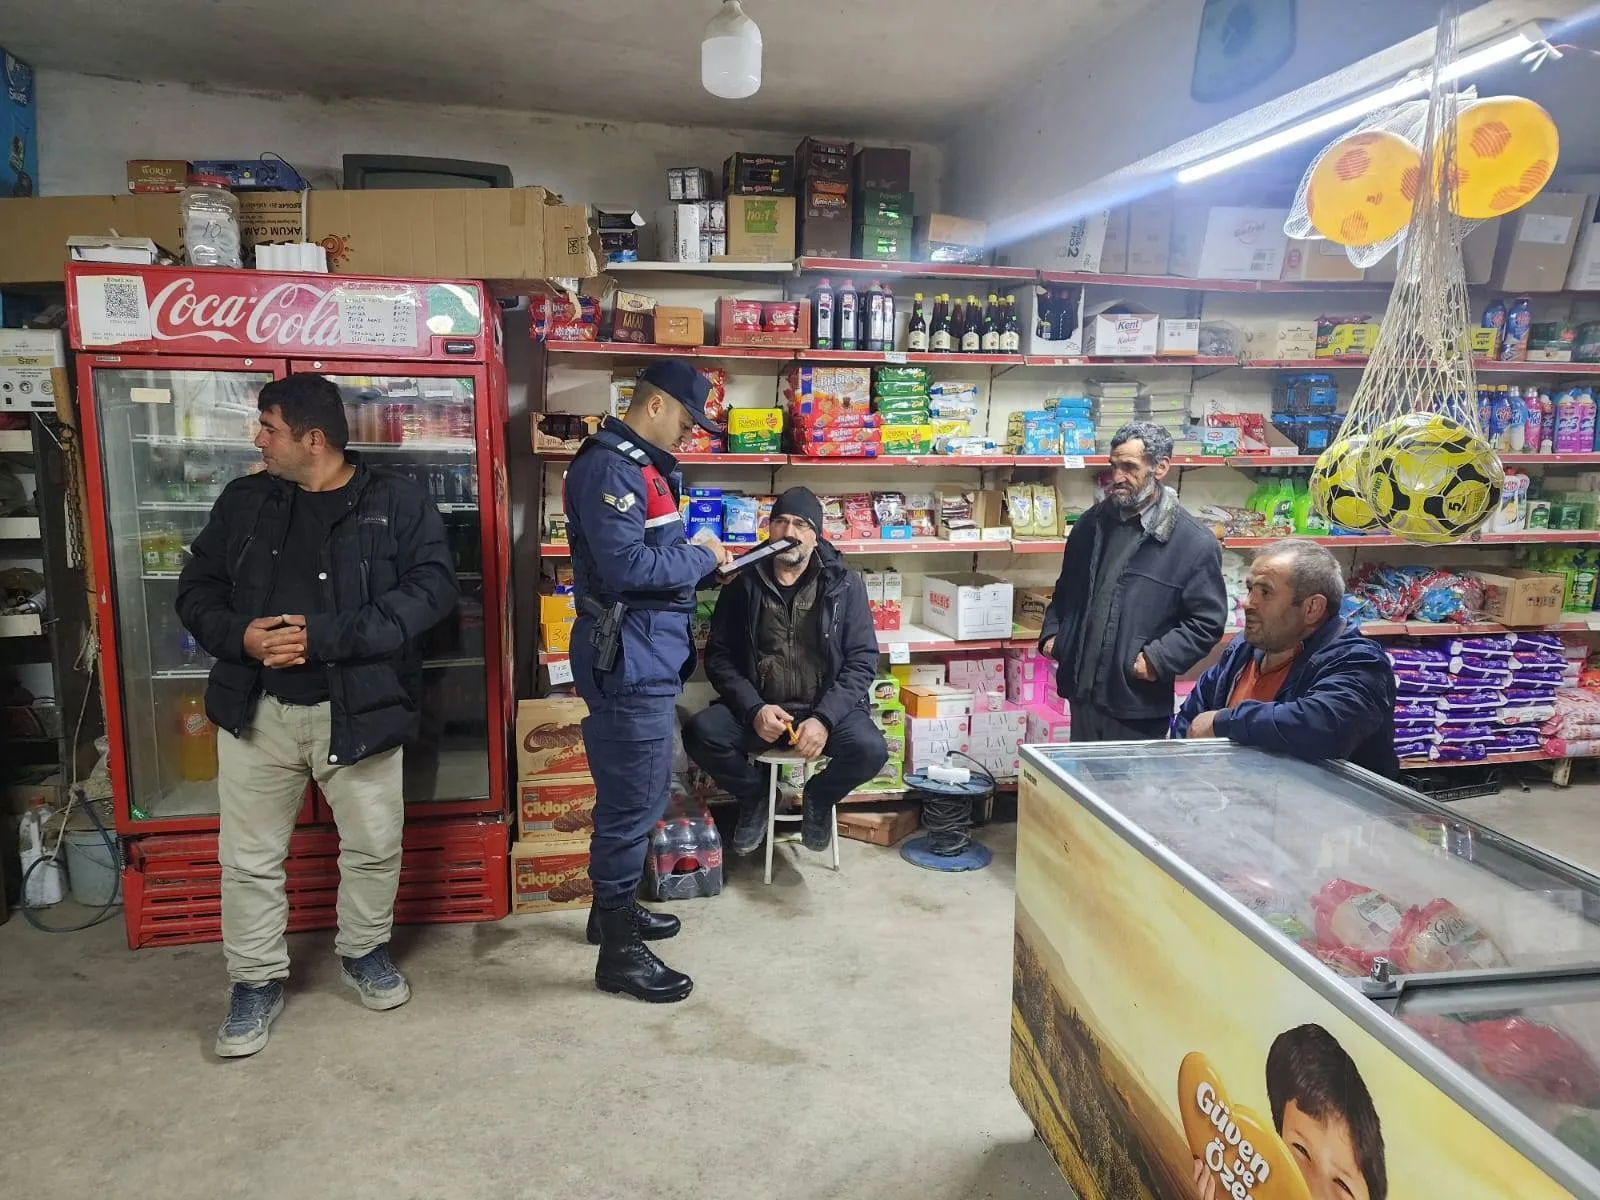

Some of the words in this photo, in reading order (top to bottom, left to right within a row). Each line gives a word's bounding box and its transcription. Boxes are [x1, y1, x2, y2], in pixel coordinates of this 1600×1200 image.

[269, 226, 303, 237] AKUM
[150, 277, 342, 346] Coca-Cola
[623, 312, 644, 328] KAKAO
[1117, 319, 1139, 331] Kent
[1448, 501, 1461, 512] 5
[523, 801, 571, 817] Çikilop
[517, 872, 566, 888] Çikilop
[1196, 1081, 1271, 1184] Güven
[1233, 1158, 1256, 1189] ve
